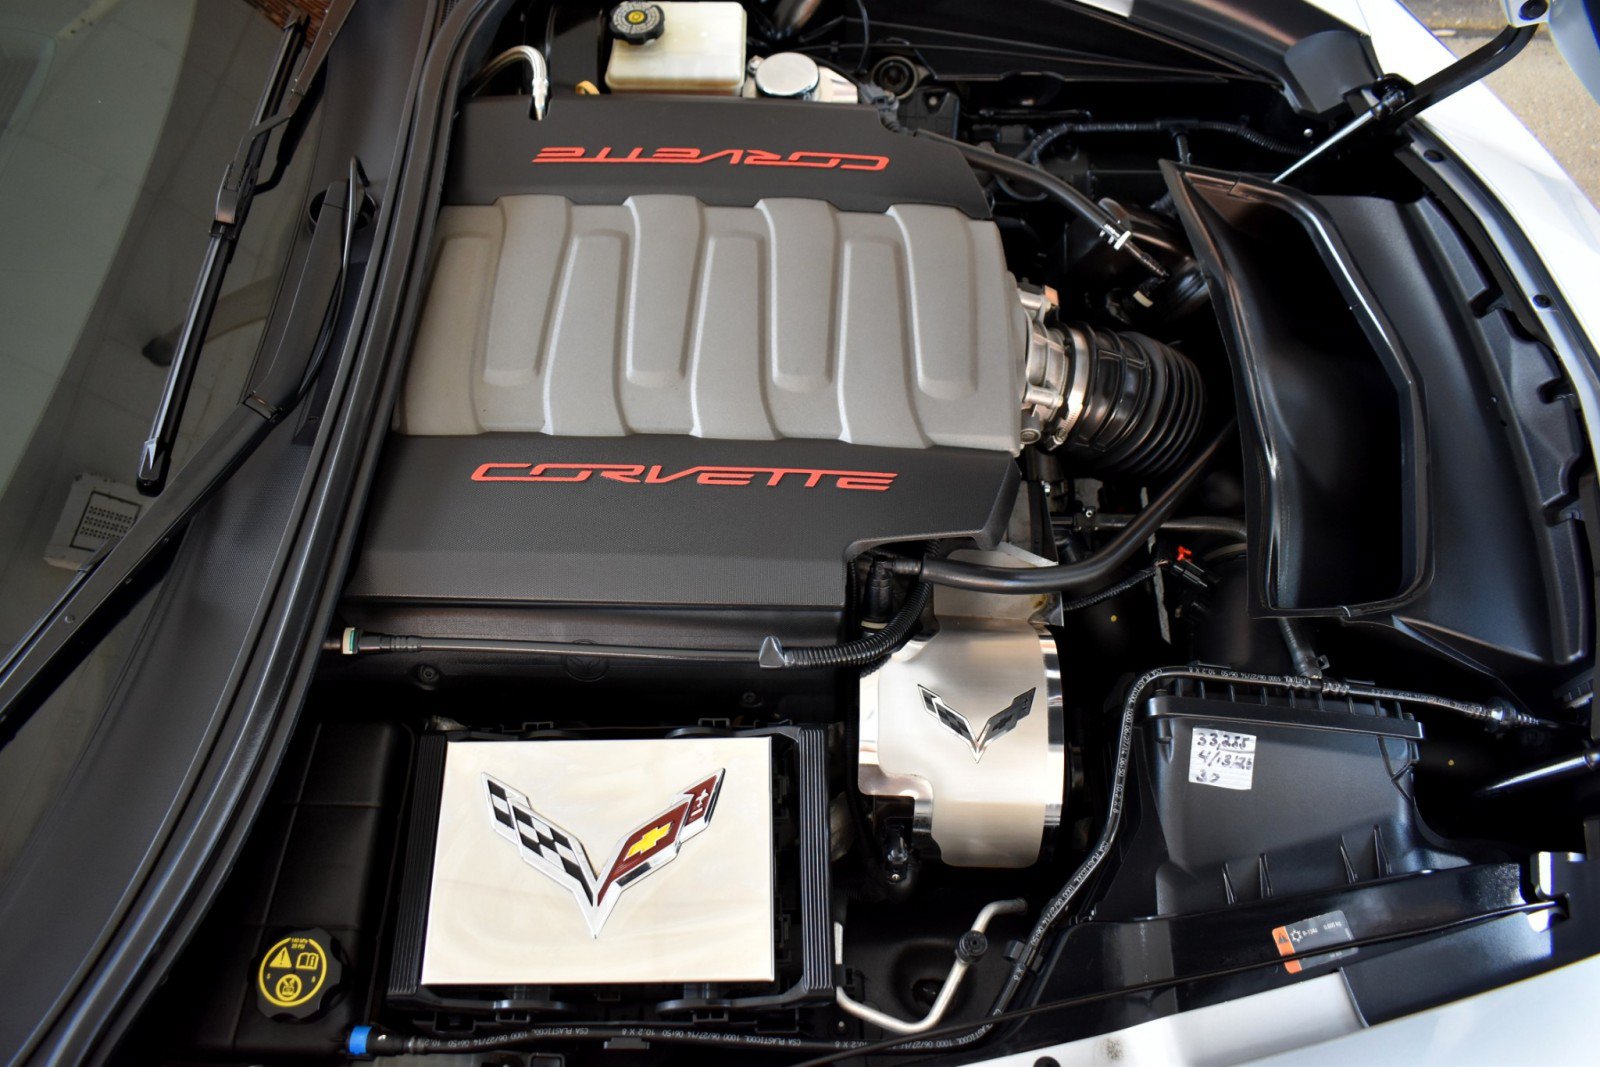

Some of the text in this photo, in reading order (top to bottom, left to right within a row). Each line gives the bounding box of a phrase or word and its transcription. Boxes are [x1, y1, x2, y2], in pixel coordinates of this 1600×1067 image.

[531, 147, 890, 171] CORVETTE
[471, 463, 898, 491] CORVETTE
[510, 1031, 528, 1040] 1000
[533, 1027, 572, 1036] PLASTICOOL
[575, 1027, 589, 1035] CSA
[687, 1031, 721, 1041] 06/27/14
[723, 1034, 740, 1042] 1000
[745, 1035, 786, 1046] PLASTICOOL
[788, 1039, 801, 1047] CSA
